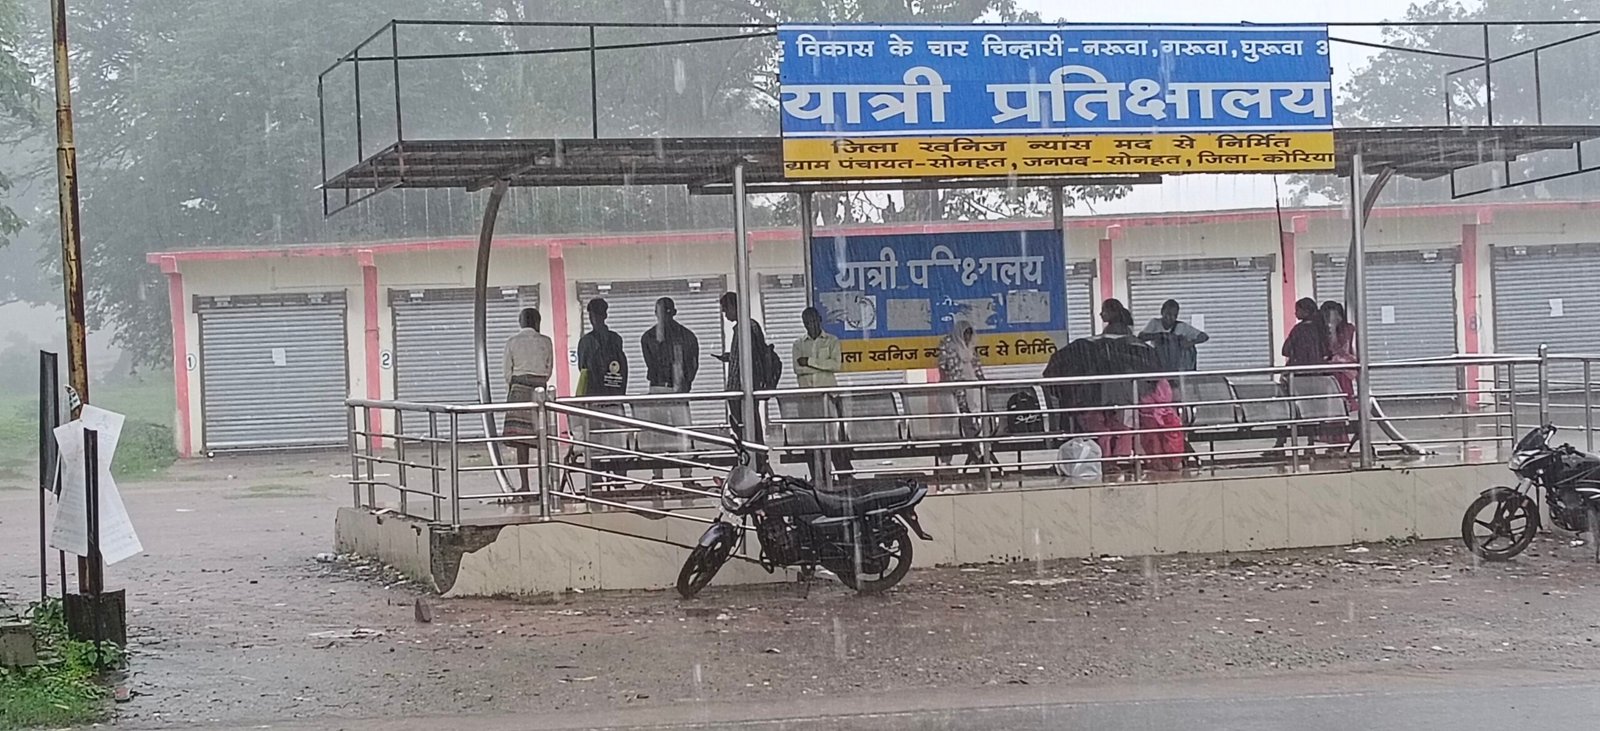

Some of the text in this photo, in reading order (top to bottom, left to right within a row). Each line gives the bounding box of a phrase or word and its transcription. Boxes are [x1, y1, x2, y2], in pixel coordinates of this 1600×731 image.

[797, 34, 874, 57] विकास
[888, 34, 913, 57] के
[927, 41, 969, 57] चार
[780, 65, 1330, 125] यात्री प्रतिक्षालय
[831, 134, 1291, 154] जिला खनिज न्यास मद से निर्मित
[785, 160, 829, 170] ग्राम
[835, 247, 898, 290] यात्री
[382, 353, 390, 366] 2
[569, 350, 577, 363] 3
[869, 346, 918, 361] खनिज
[996, 340, 1009, 355] से
[1015, 338, 1057, 354] निर्मित
